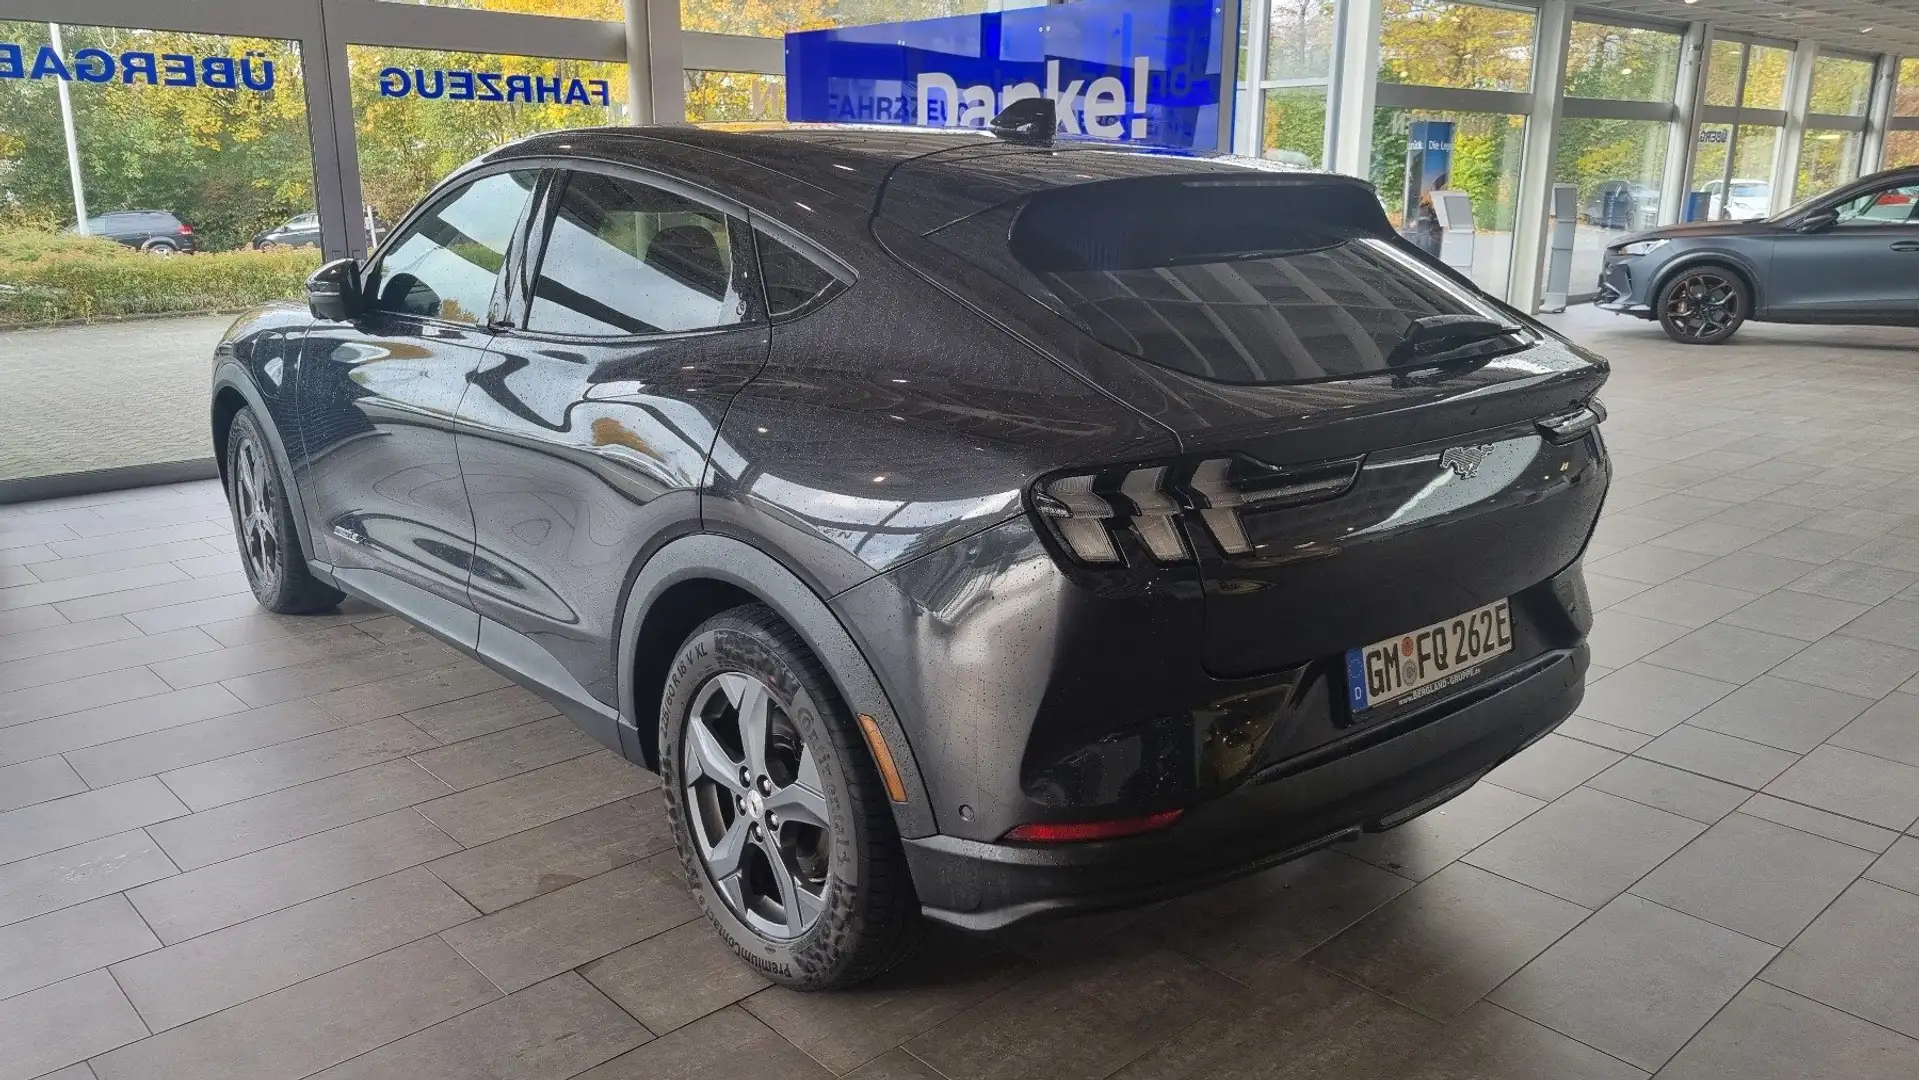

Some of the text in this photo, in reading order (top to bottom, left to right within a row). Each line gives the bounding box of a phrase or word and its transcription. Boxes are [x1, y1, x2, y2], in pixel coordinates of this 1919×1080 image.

[1366, 603, 1510, 697] GM FQ 262E
[1354, 686, 1362, 700] D
